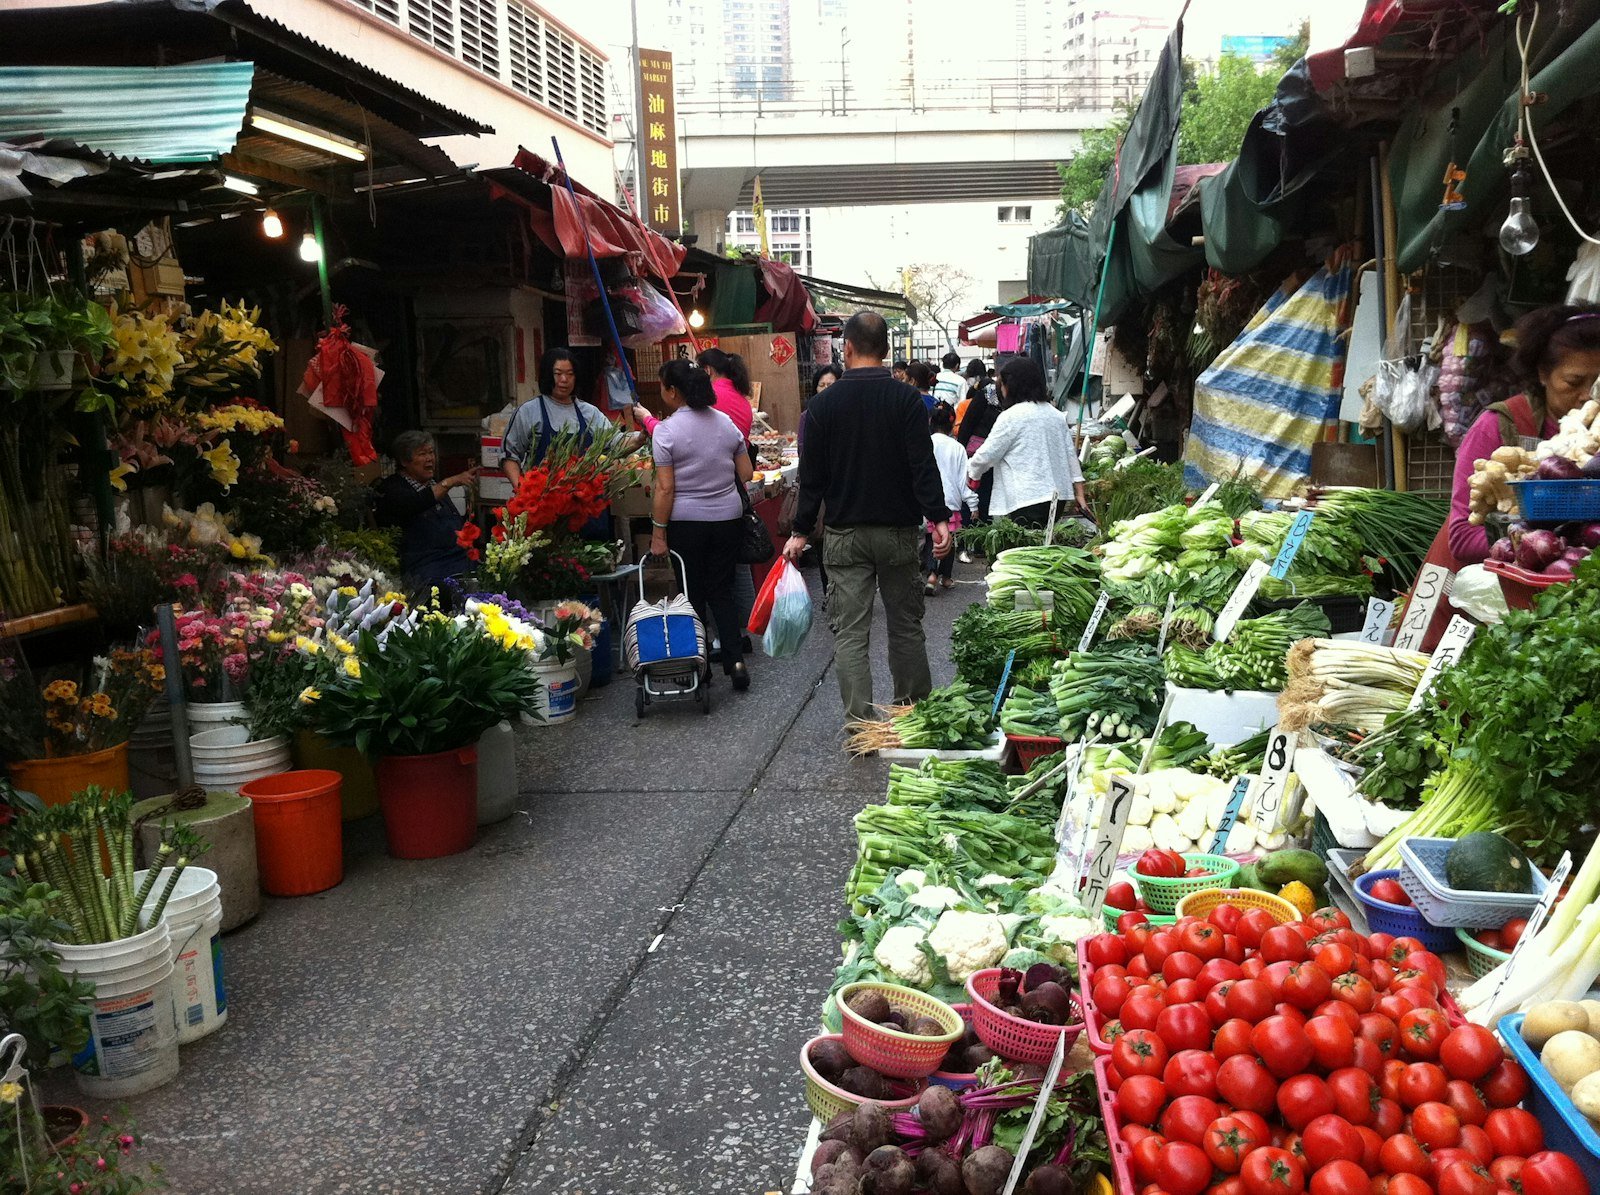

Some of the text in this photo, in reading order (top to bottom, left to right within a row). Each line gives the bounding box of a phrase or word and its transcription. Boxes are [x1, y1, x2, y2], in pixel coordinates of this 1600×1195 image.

[643, 72, 667, 83] MARKET
[648, 93, 669, 224] 油麻地街市
